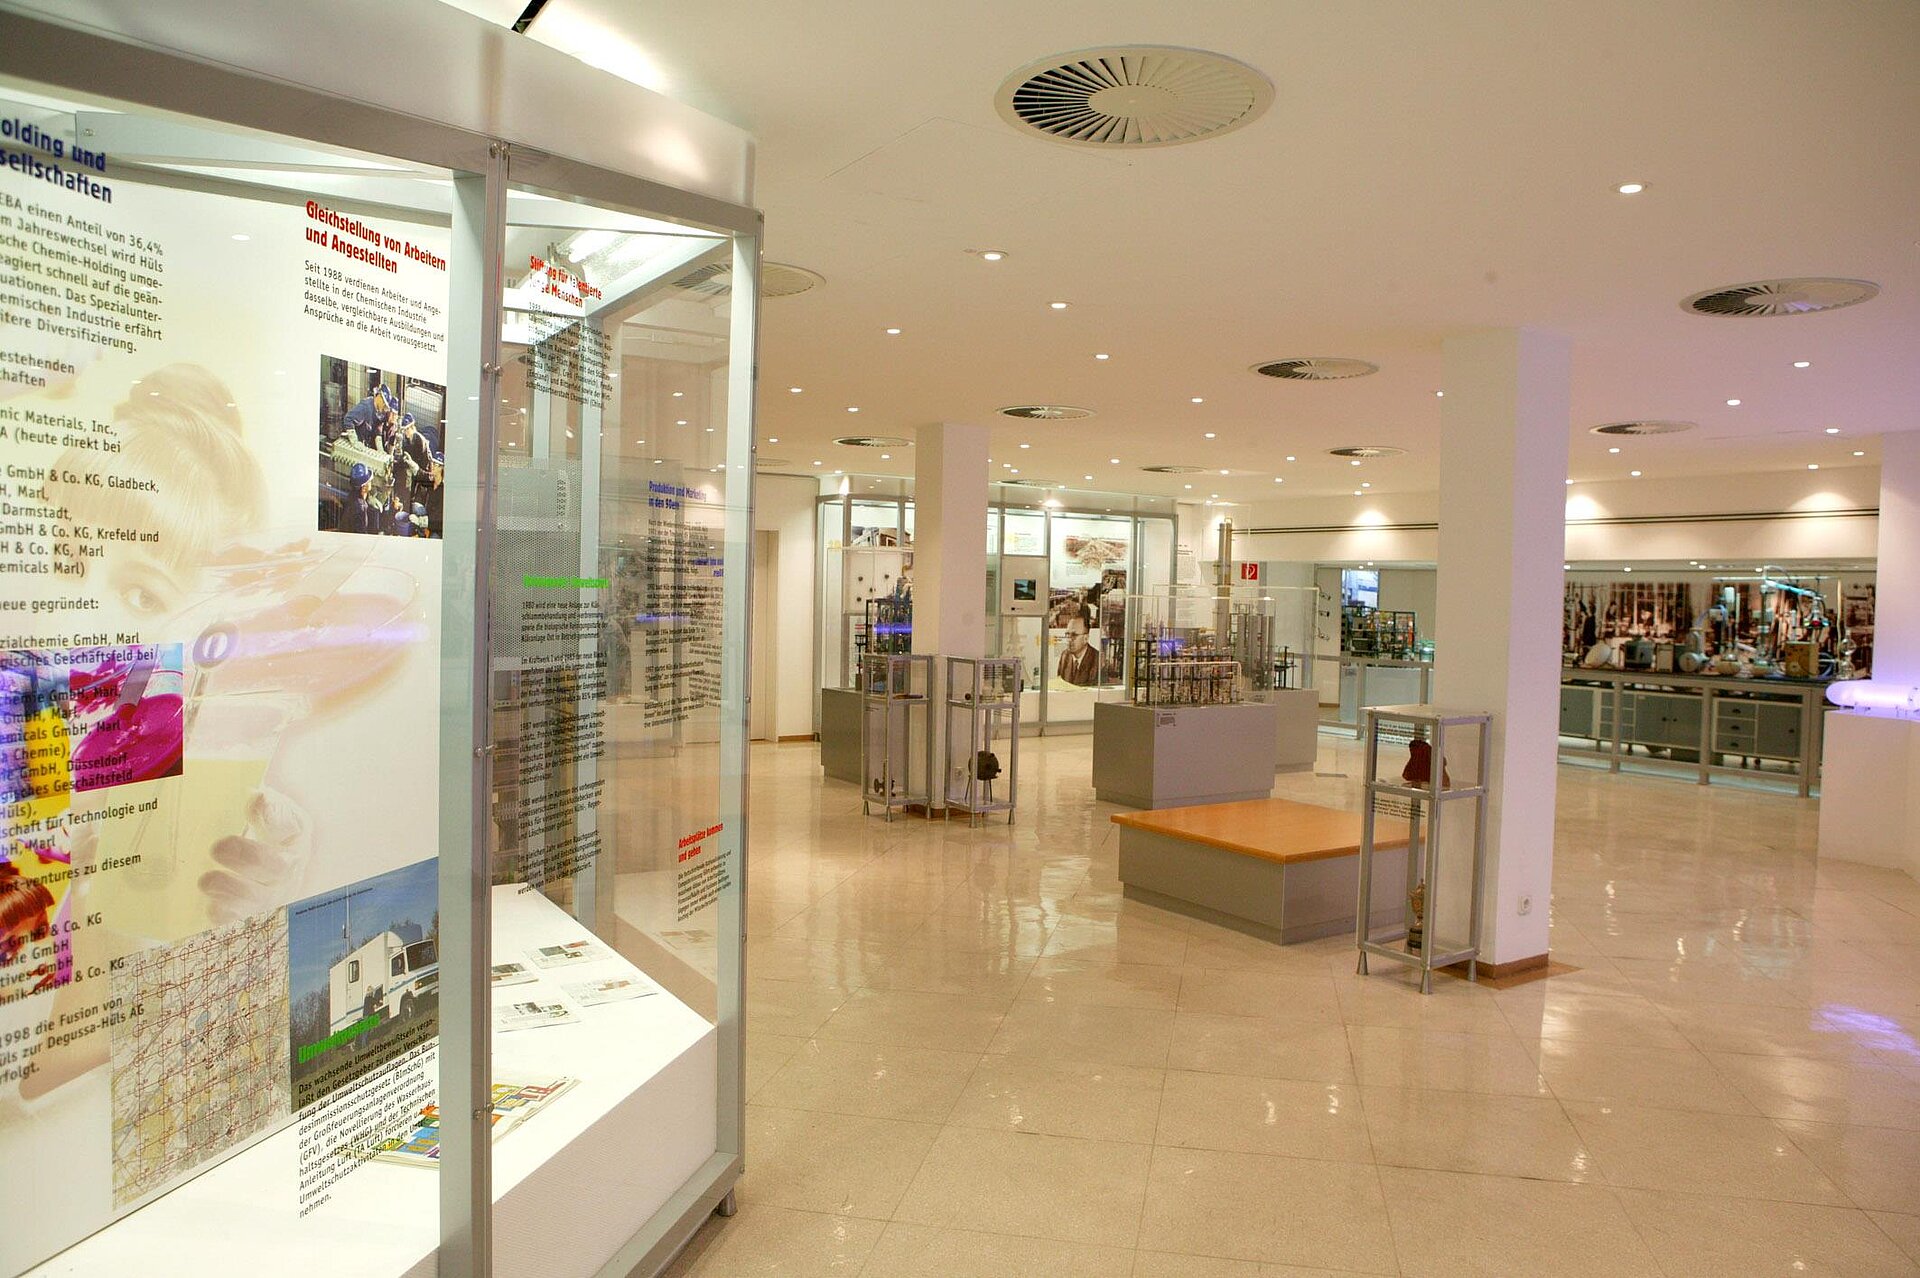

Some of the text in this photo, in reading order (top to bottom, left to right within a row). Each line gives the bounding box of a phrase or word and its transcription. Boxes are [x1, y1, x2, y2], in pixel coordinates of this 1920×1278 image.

[72, 145, 106, 172] und
[27, 203, 164, 256] einen Anteil von 36,4%
[306, 199, 447, 273] Gleichstellung von Arbeitern
[17, 217, 164, 274] Jahreswechsel wird Hüls
[305, 226, 398, 275] und Angestellten
[32, 241, 163, 289] Chemie-Holding umge-
[46, 264, 163, 306] schnell auf die geän-
[304, 258, 321, 275] Seit
[323, 267, 343, 283] 1988
[344, 275, 380, 296] verdienen
[381, 287, 409, 305] Arbeiter
[423, 301, 441, 316] Ange-
[65, 287, 87, 305] Das
[90, 293, 163, 322] Spezialunter-
[304, 275, 427, 325] stellte in der Chemischen Industrie
[66, 306, 121, 331] Industrie
[124, 322, 163, 341] erfährt
[303, 303, 438, 353] Ansprüche an die Arbeit vorausgesetzt.
[304, 290, 445, 342] dasselbe, vergleichbare Ausbildungen und
[37, 317, 137, 354] Diversifizierung.
[25, 410, 118, 437] Materials, Inc.,
[14, 427, 121, 453] (heute direkt bei
[7, 464, 160, 493] GmbH & Co. KG, Gladbeck,
[18, 485, 50, 502] Marl,
[2, 502, 73, 521] Darmstadt,
[39, 523, 160, 543] & Co. KG, Krefeld und
[15, 541, 104, 558] & Co. KG, Marl
[54, 562, 85, 578] Marl)
[31, 597, 100, 614] gegründet:
[73, 633, 112, 648] GmbH,
[116, 632, 140, 645] Marl
[54, 648, 154, 666] Geschäftsfeld bei
[52, 722, 91, 738] GmbH,
[67, 802, 136, 827] Technologie
[138, 797, 159, 814] und
[83, 853, 142, 877] zu diesem
[50, 923, 59, 937] &
[87, 911, 103, 928] KG
[31, 939, 70, 960] GmbH
[75, 956, 126, 984] & Co. KG
[35, 996, 123, 1037] die Fusion von
[22, 1003, 145, 1060] zur Degussa-Hüls AG
[425, 1051, 436, 1064] mit
[299, 1082, 313, 1095] Das
[314, 1060, 353, 1086] wachsende
[317, 1083, 330, 1099] den
[332, 1062, 374, 1092] Gesetzgeber
[376, 1056, 385, 1067] zu
[325, 1135, 338, 1148] die
[339, 1108, 383, 1139] Novellierung
[384, 1099, 396, 1113] des
[299, 1136, 311, 1151] der
[299, 1163, 335, 1192] Anleitung
[337, 1150, 353, 1168] Luft
[299, 1194, 332, 1219] nehmen.
